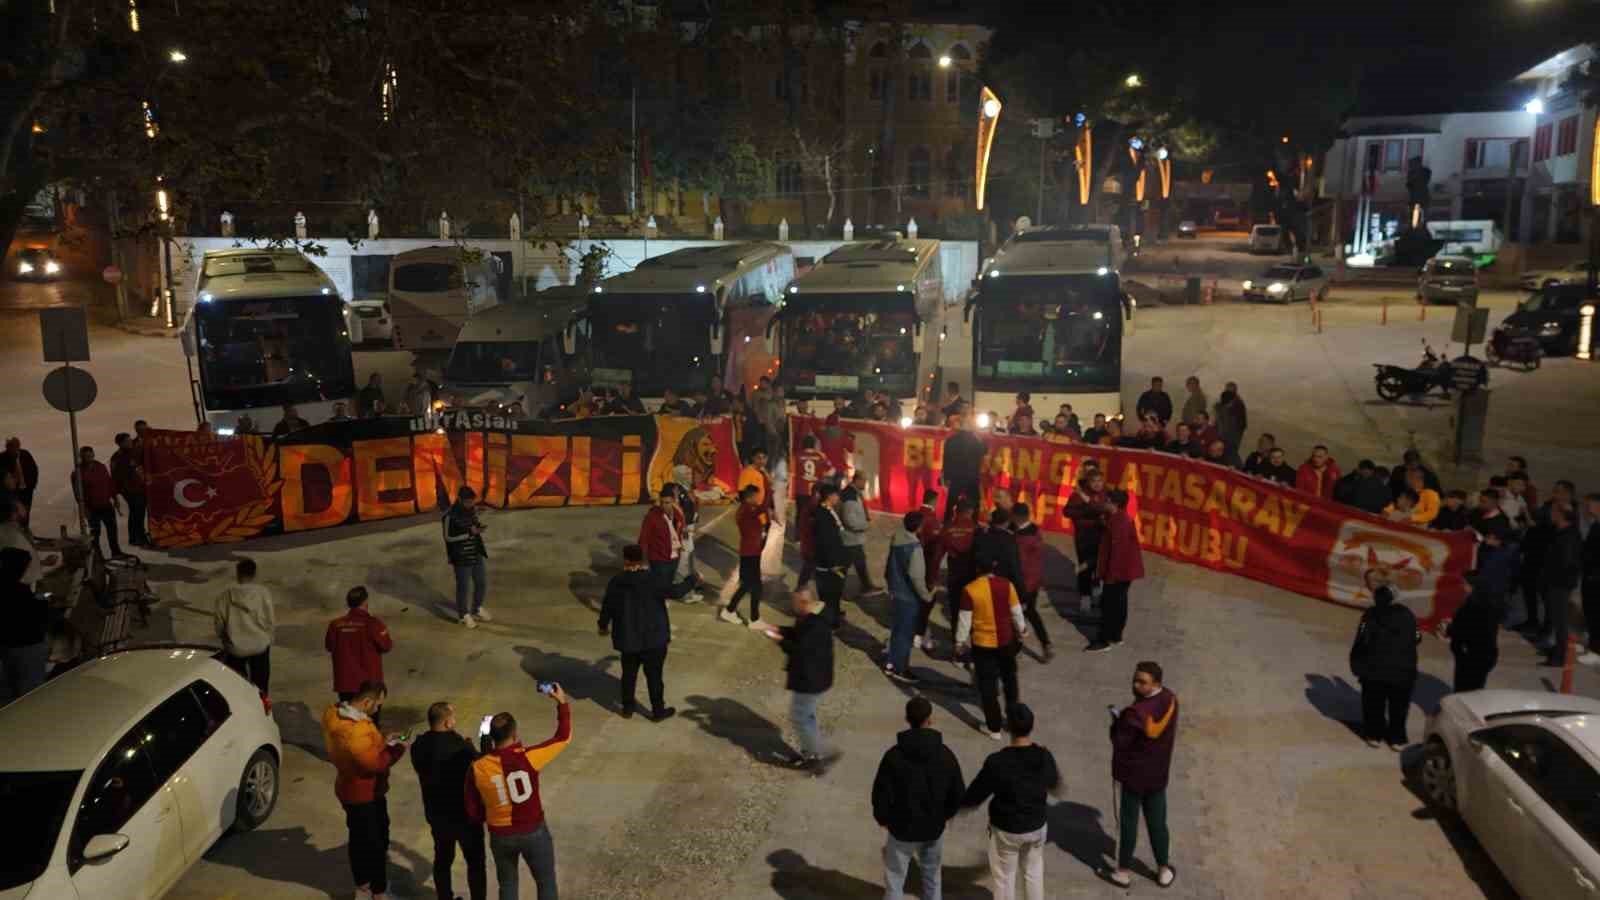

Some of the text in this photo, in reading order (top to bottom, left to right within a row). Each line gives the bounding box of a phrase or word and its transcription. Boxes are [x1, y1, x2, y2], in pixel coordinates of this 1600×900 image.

[803, 460, 817, 478] 9
[1135, 509, 1248, 569] GRUBU
[490, 770, 533, 805] 10
